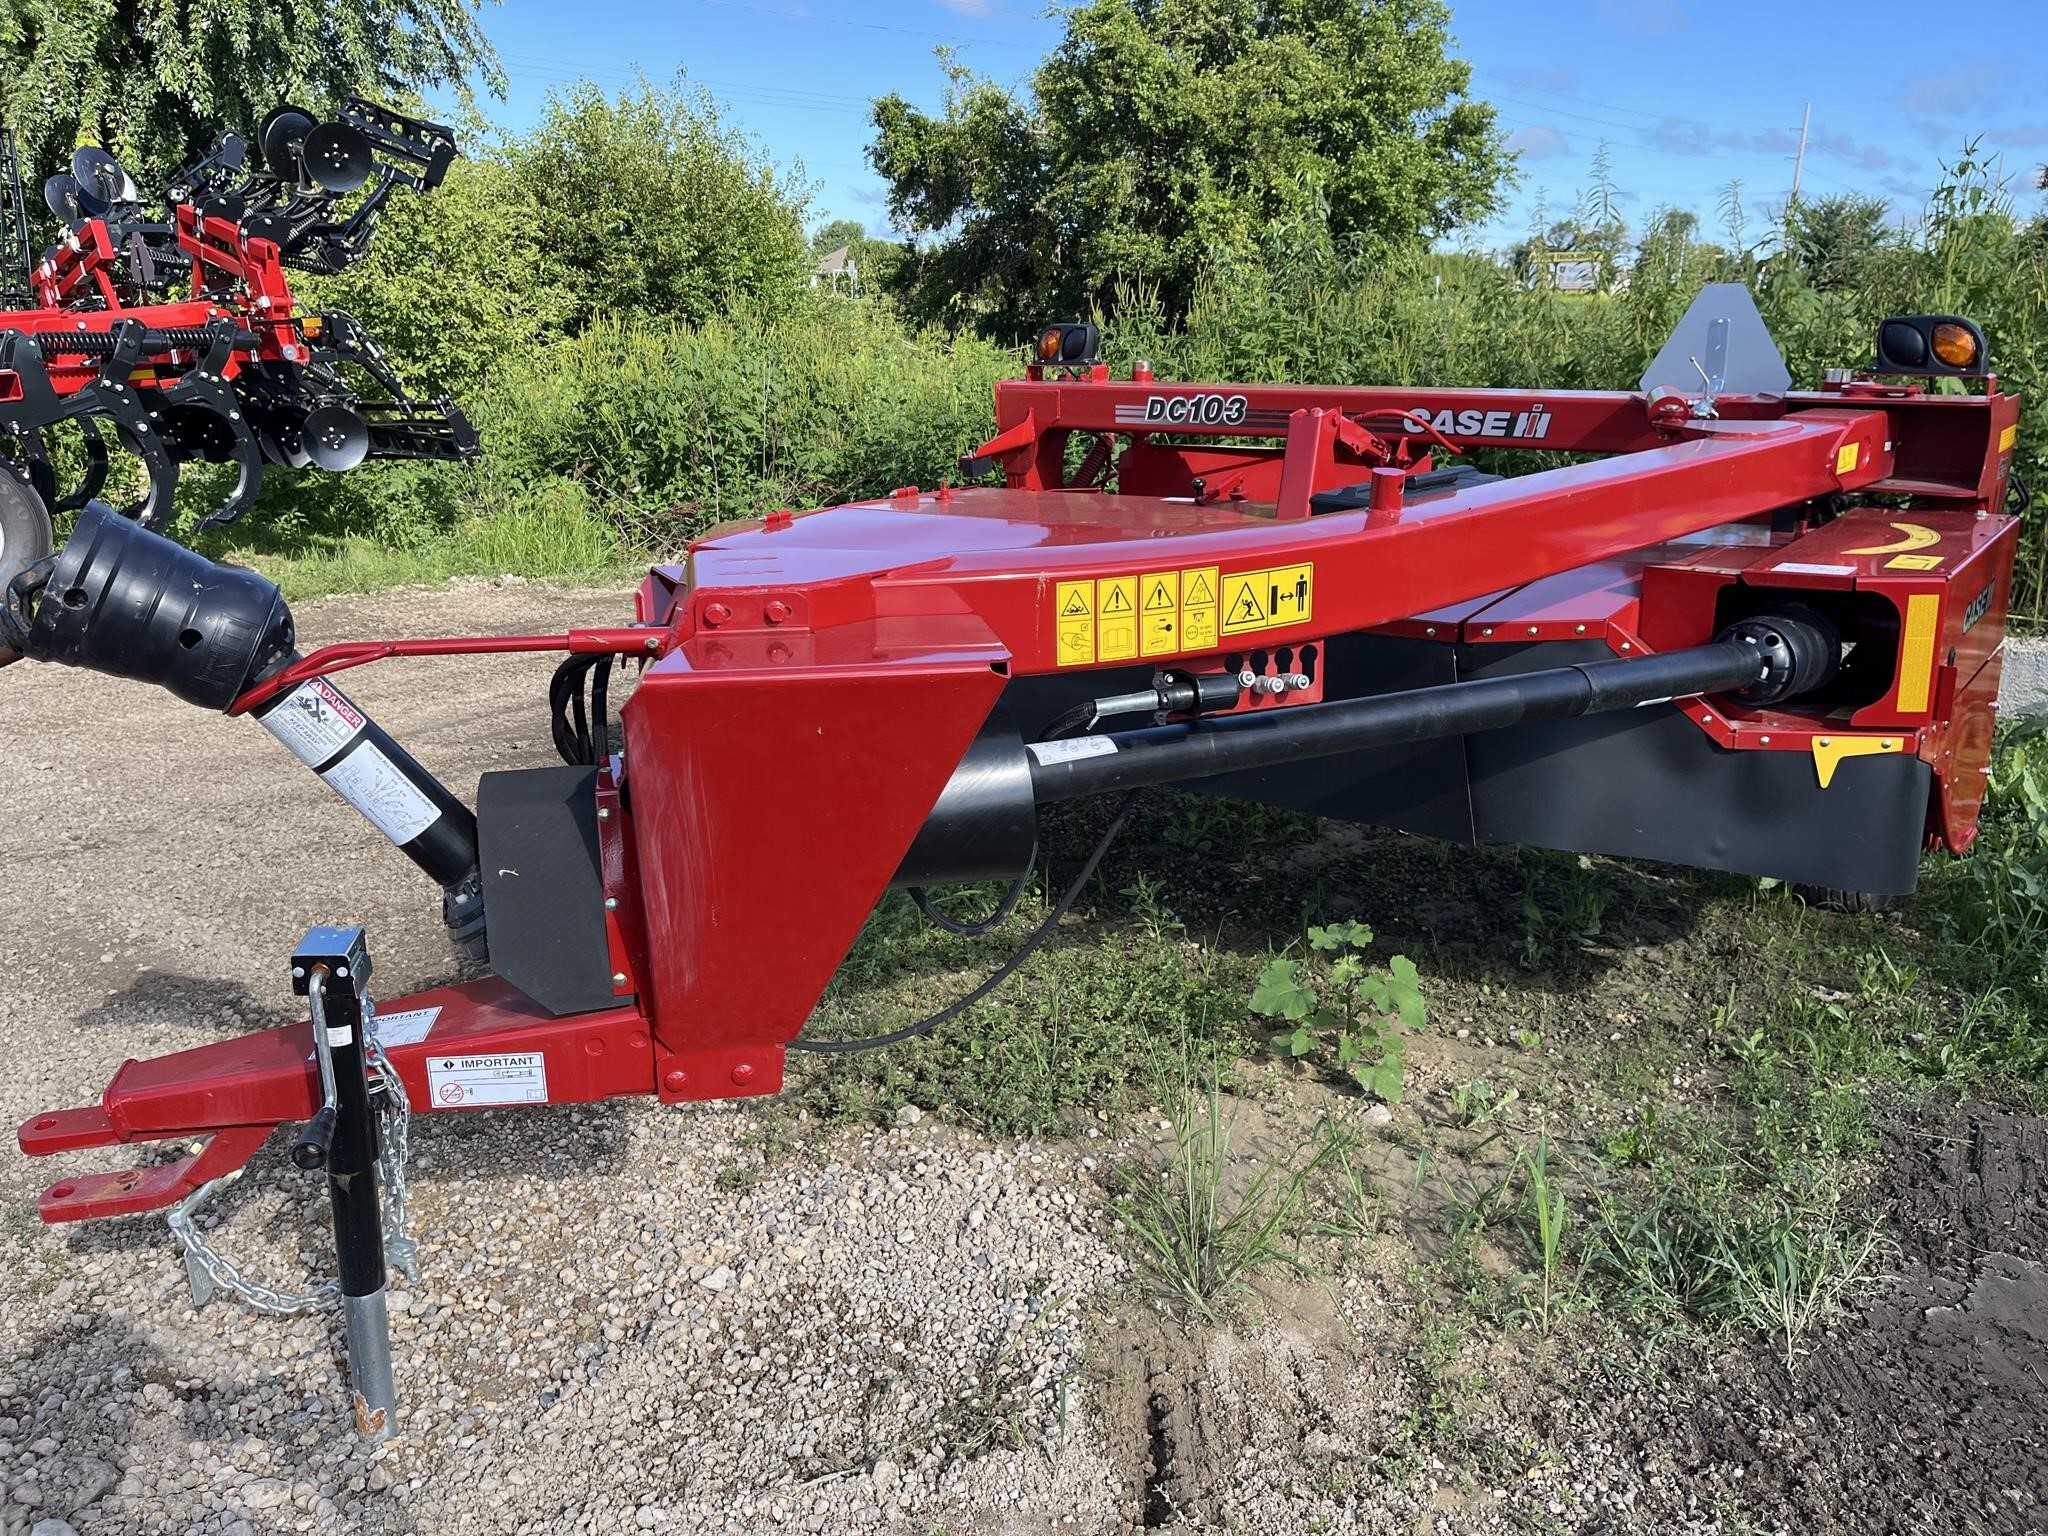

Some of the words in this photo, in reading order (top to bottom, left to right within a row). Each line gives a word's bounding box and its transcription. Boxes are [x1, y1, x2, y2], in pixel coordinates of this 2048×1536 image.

[1145, 395, 1248, 425] DC103
[1403, 407, 1511, 437] CASE
[321, 687, 362, 729] DANGER
[375, 1010, 431, 1023] PORTANT
[461, 1056, 534, 1069] IMPORTANT
